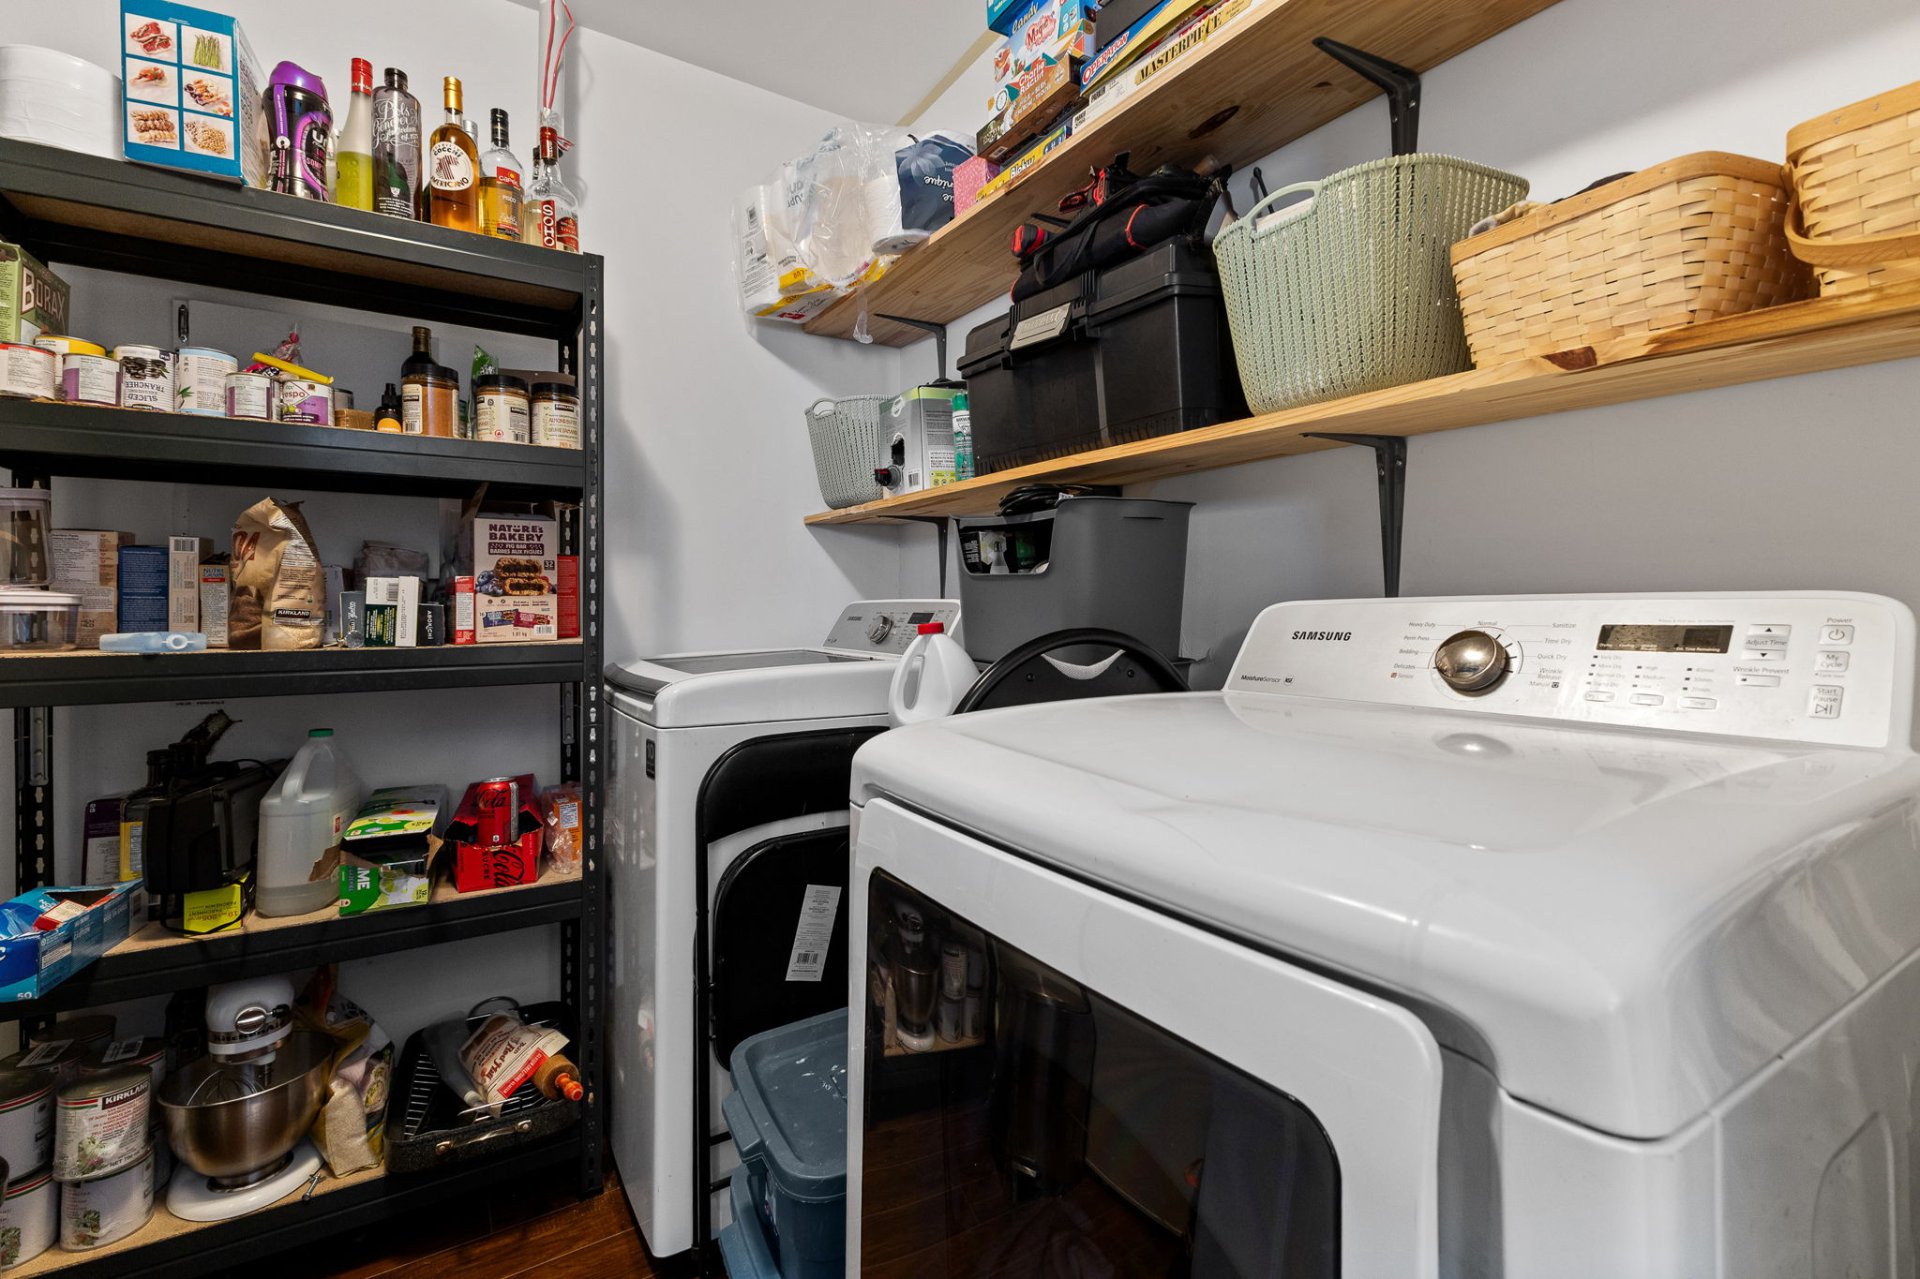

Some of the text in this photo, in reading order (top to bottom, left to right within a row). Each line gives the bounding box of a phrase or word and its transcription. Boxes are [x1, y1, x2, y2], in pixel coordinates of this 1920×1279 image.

[1138, 11, 1222, 82] MASTERPIECE
[1082, 31, 1130, 85] OPERATION
[542, 203, 555, 247] SOHO
[22, 264, 66, 325] BORAX
[489, 532, 544, 542] BAKERY
[544, 559, 554, 569] 32
[1291, 630, 1352, 641] SAMSUNG
[1560, 638, 1572, 646] Dry
[1556, 653, 1568, 662] Dry
[1825, 654, 1839, 662] My
[105, 1082, 150, 1106] KIRKLAND
